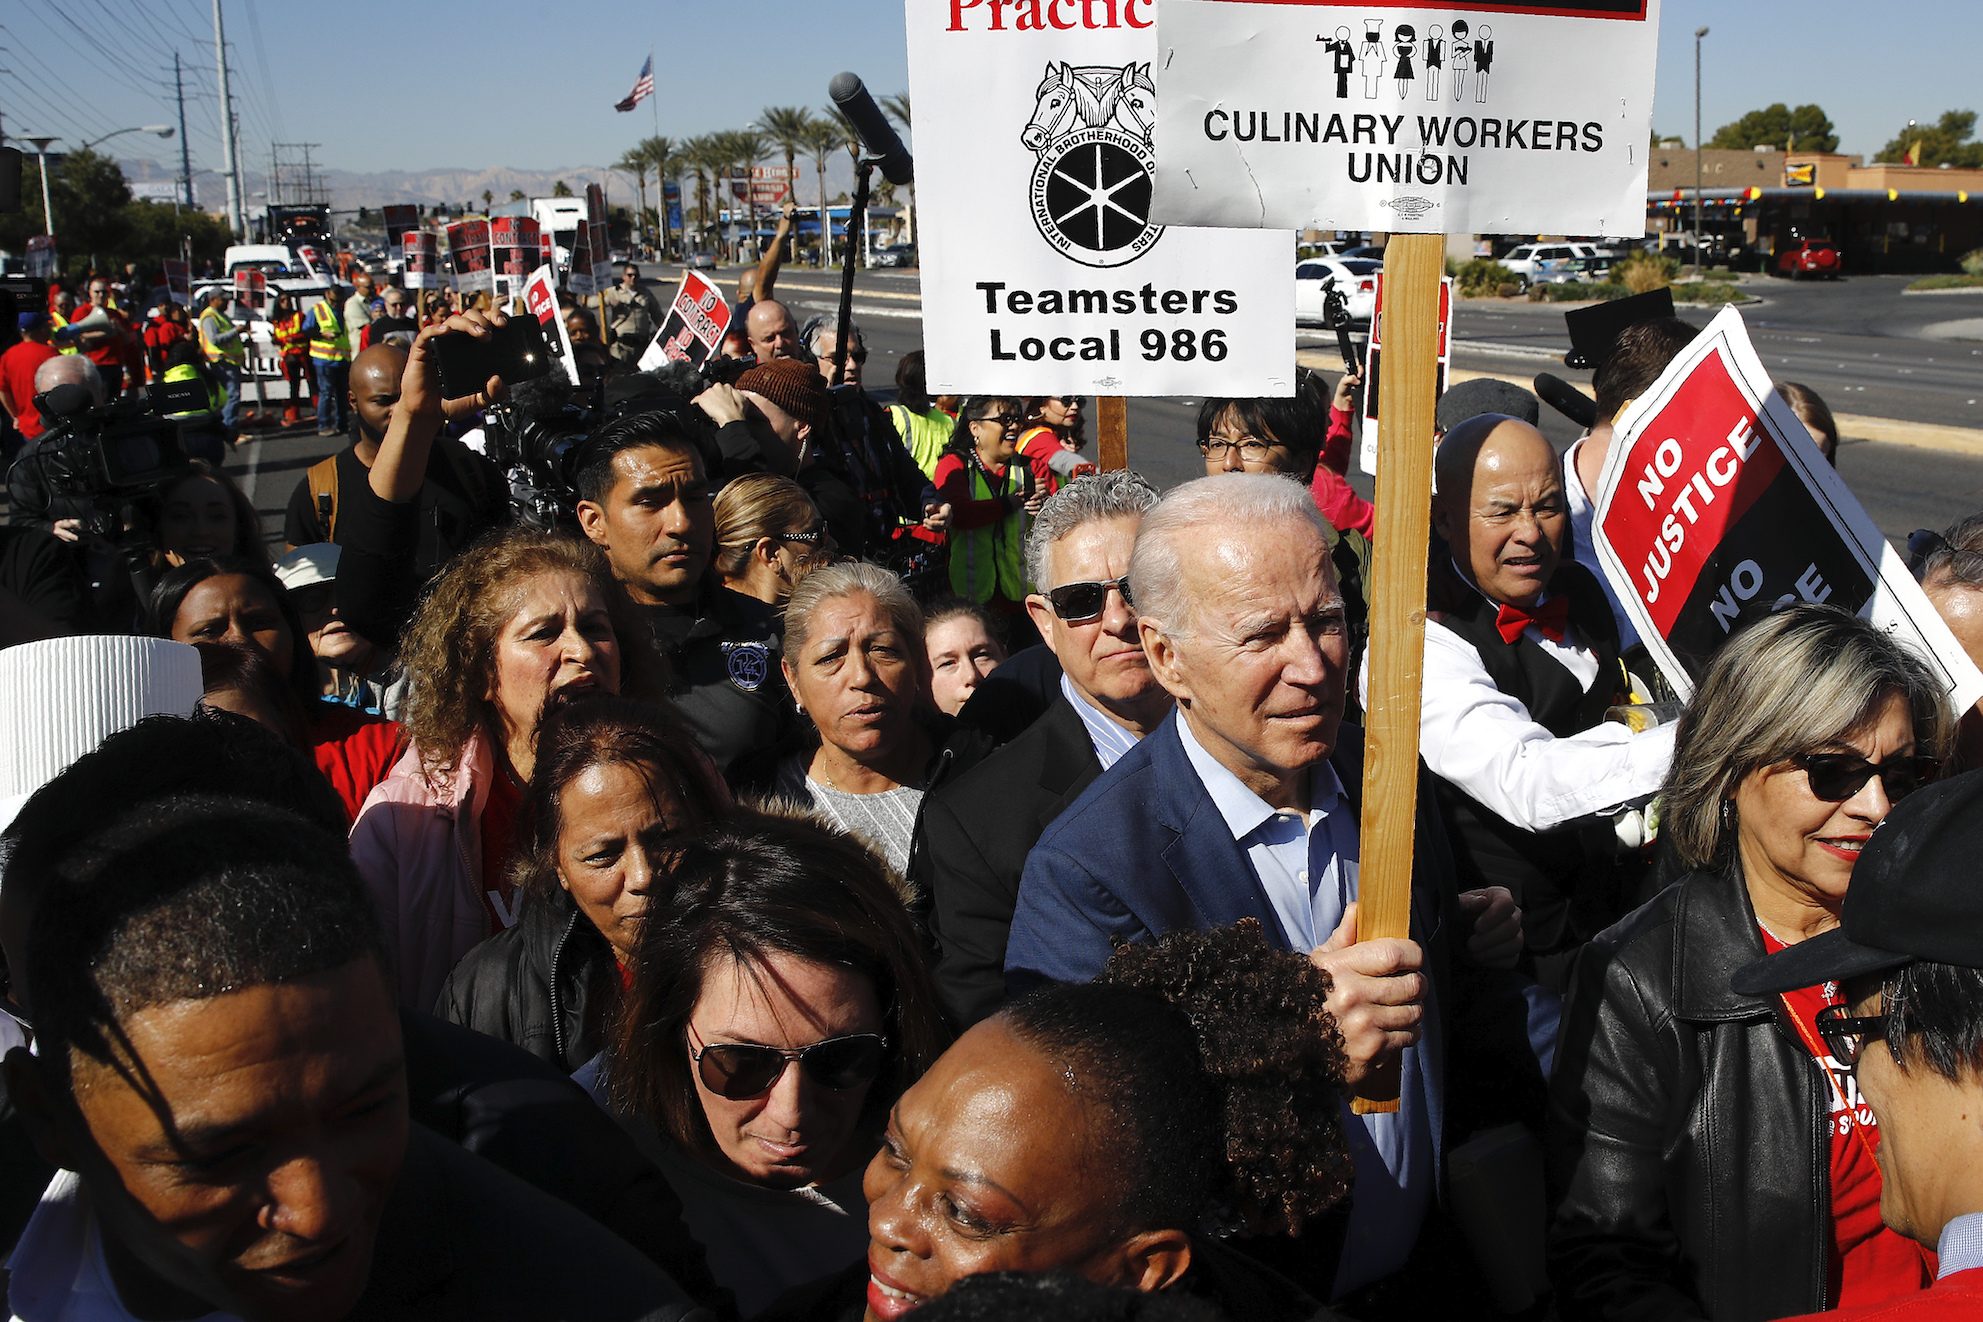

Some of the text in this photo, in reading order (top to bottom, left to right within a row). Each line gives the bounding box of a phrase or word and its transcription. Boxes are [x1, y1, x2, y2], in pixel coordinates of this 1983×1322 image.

[1203, 109, 1604, 153] CULINARY WORKERS
[1034, 155, 1071, 251] INTERNATIONAL
[1055, 130, 1147, 161] BROTHERHOOD
[1348, 152, 1468, 186] UNION
[976, 282, 1239, 315] Teamsters
[990, 328, 1229, 362] Local 986
[1637, 438, 1683, 511] NO
[1645, 414, 1763, 604] JUSTICE
[1709, 558, 1764, 634] NO
